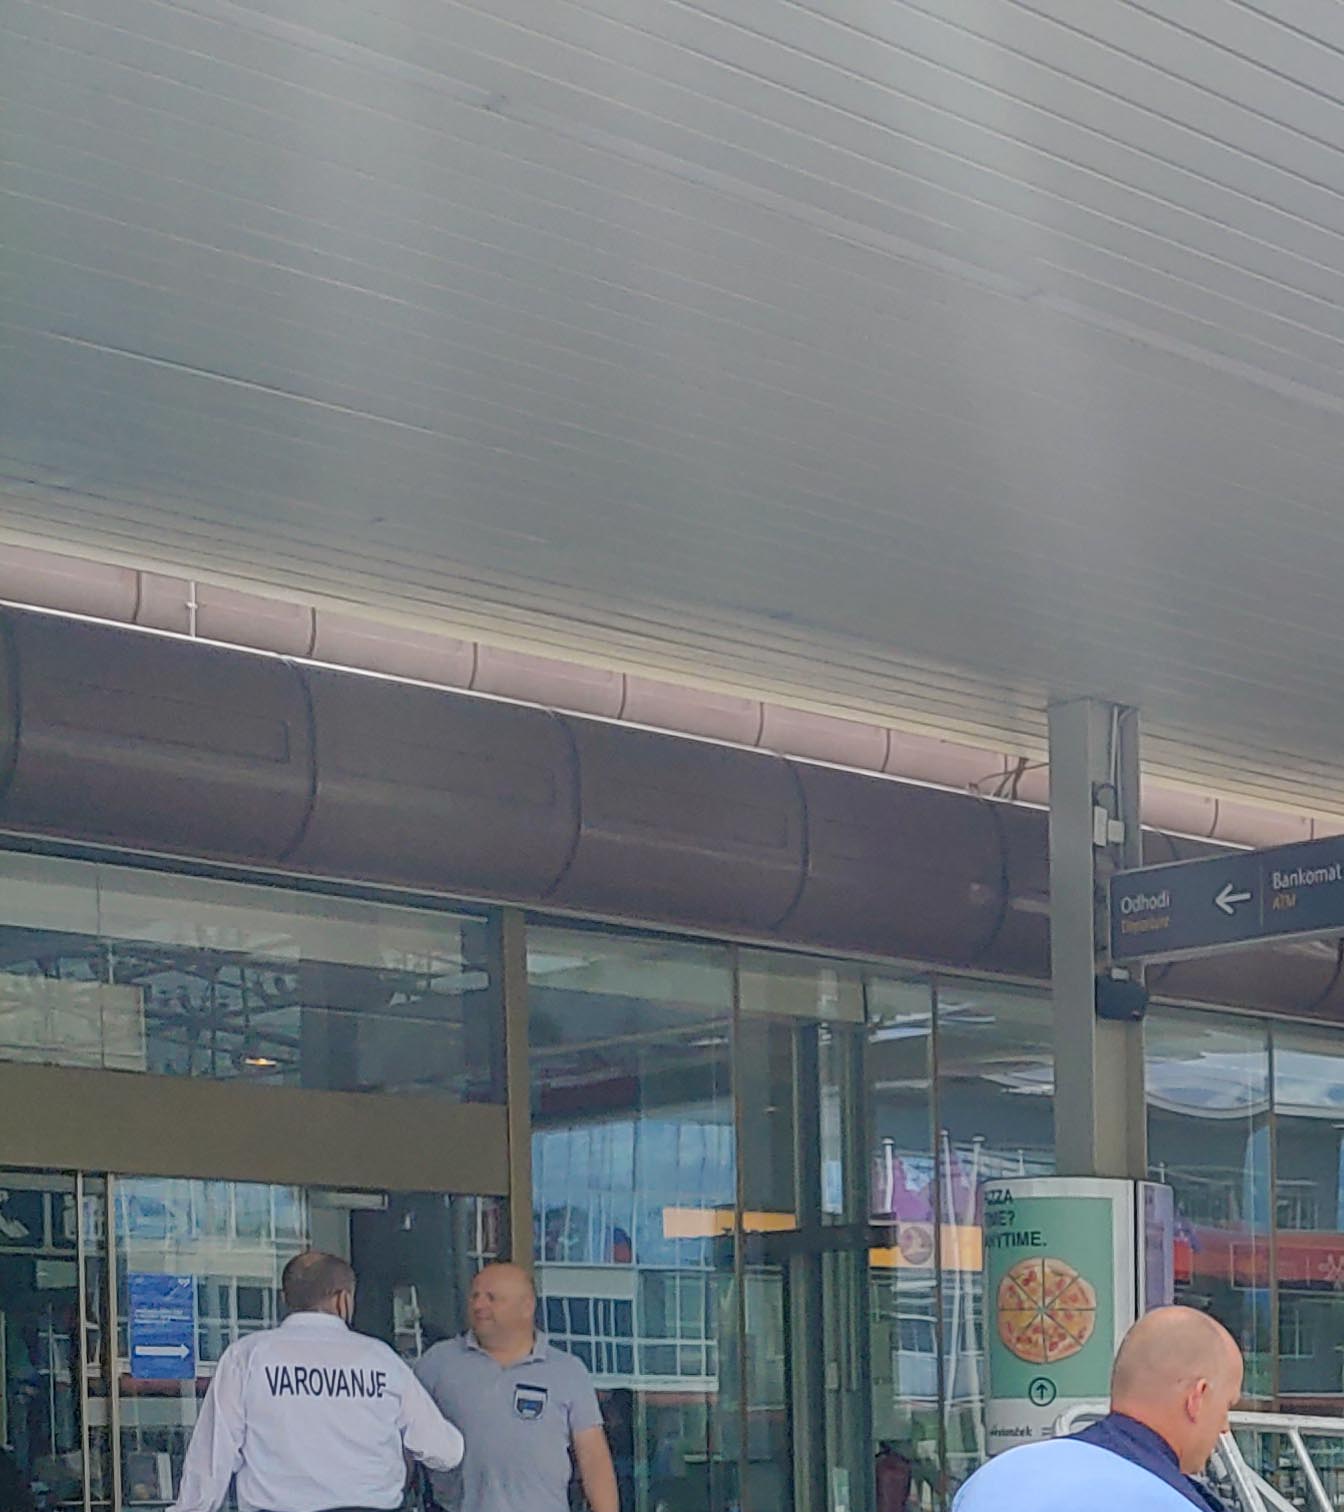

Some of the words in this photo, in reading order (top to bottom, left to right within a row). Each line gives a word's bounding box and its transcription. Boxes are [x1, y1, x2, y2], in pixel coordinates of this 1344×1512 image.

[1272, 863, 1343, 890] Bankomat
[1120, 889, 1171, 914] Odhodi
[265, 1366, 387, 1398] VAROVANJE
